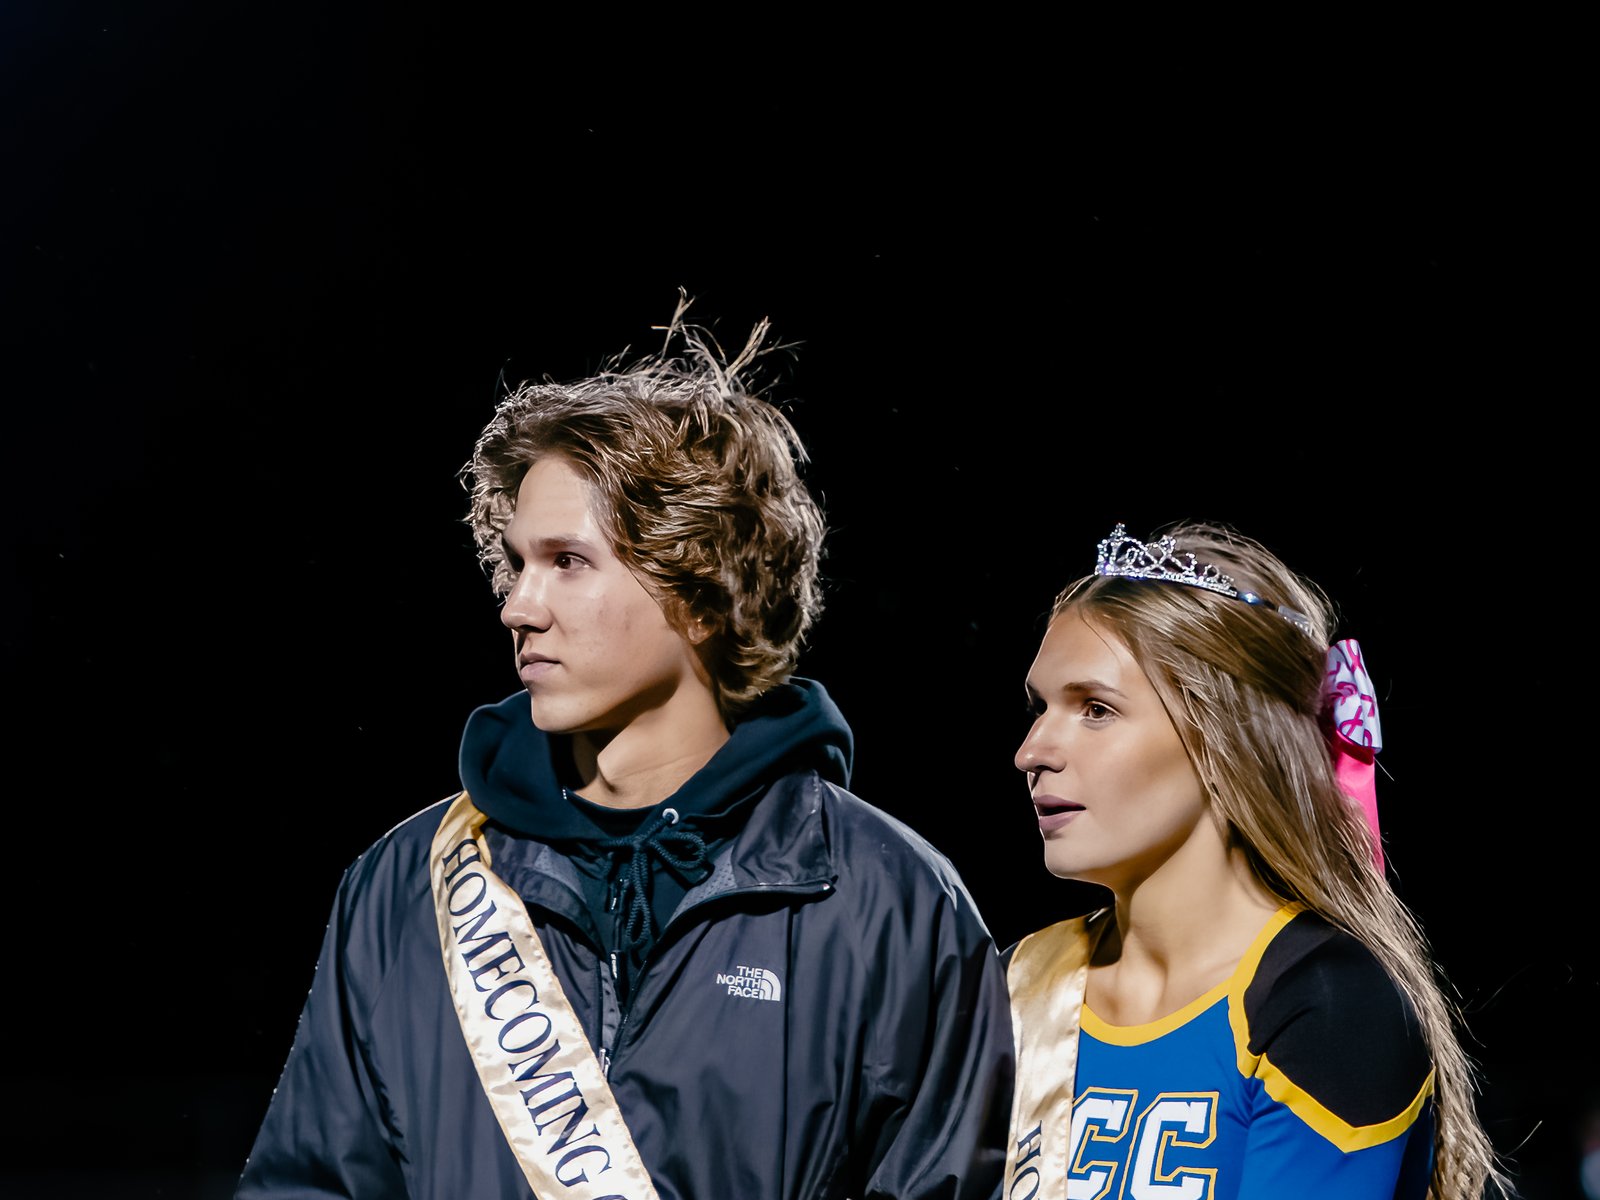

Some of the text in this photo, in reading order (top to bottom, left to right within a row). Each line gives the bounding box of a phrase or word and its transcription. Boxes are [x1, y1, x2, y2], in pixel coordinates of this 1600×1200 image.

[736, 965, 763, 979] THE
[716, 973, 762, 989] NORTH
[727, 985, 760, 999] FACE
[441, 838, 613, 1189] HOMECOMING
